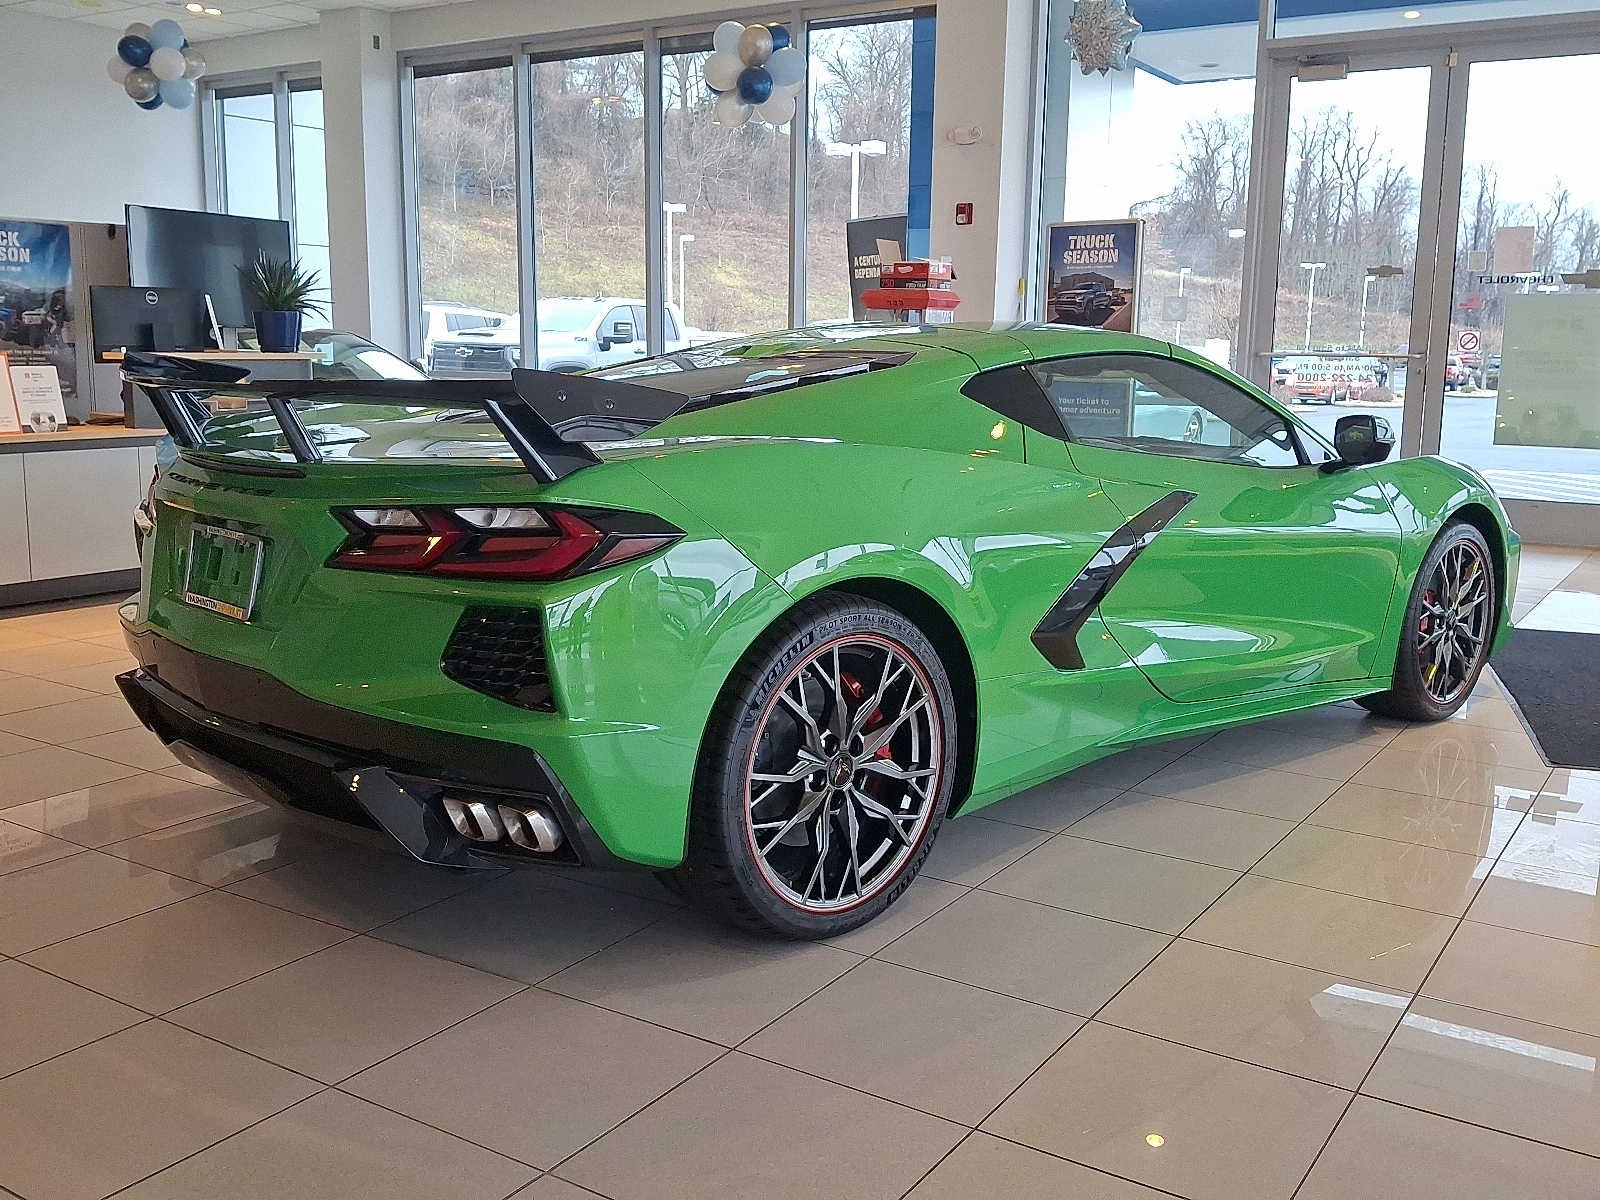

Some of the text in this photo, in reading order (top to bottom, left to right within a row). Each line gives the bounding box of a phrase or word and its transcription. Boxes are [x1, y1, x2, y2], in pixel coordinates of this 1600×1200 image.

[1068, 233, 1115, 249] TRUCK
[854, 256, 860, 266] A
[1063, 248, 1119, 264] SEASON
[755, 634, 812, 706] MICHELIN
[819, 619, 838, 632] PILOT
[839, 614, 861, 625] SPORT
[863, 614, 875, 622] ALL
